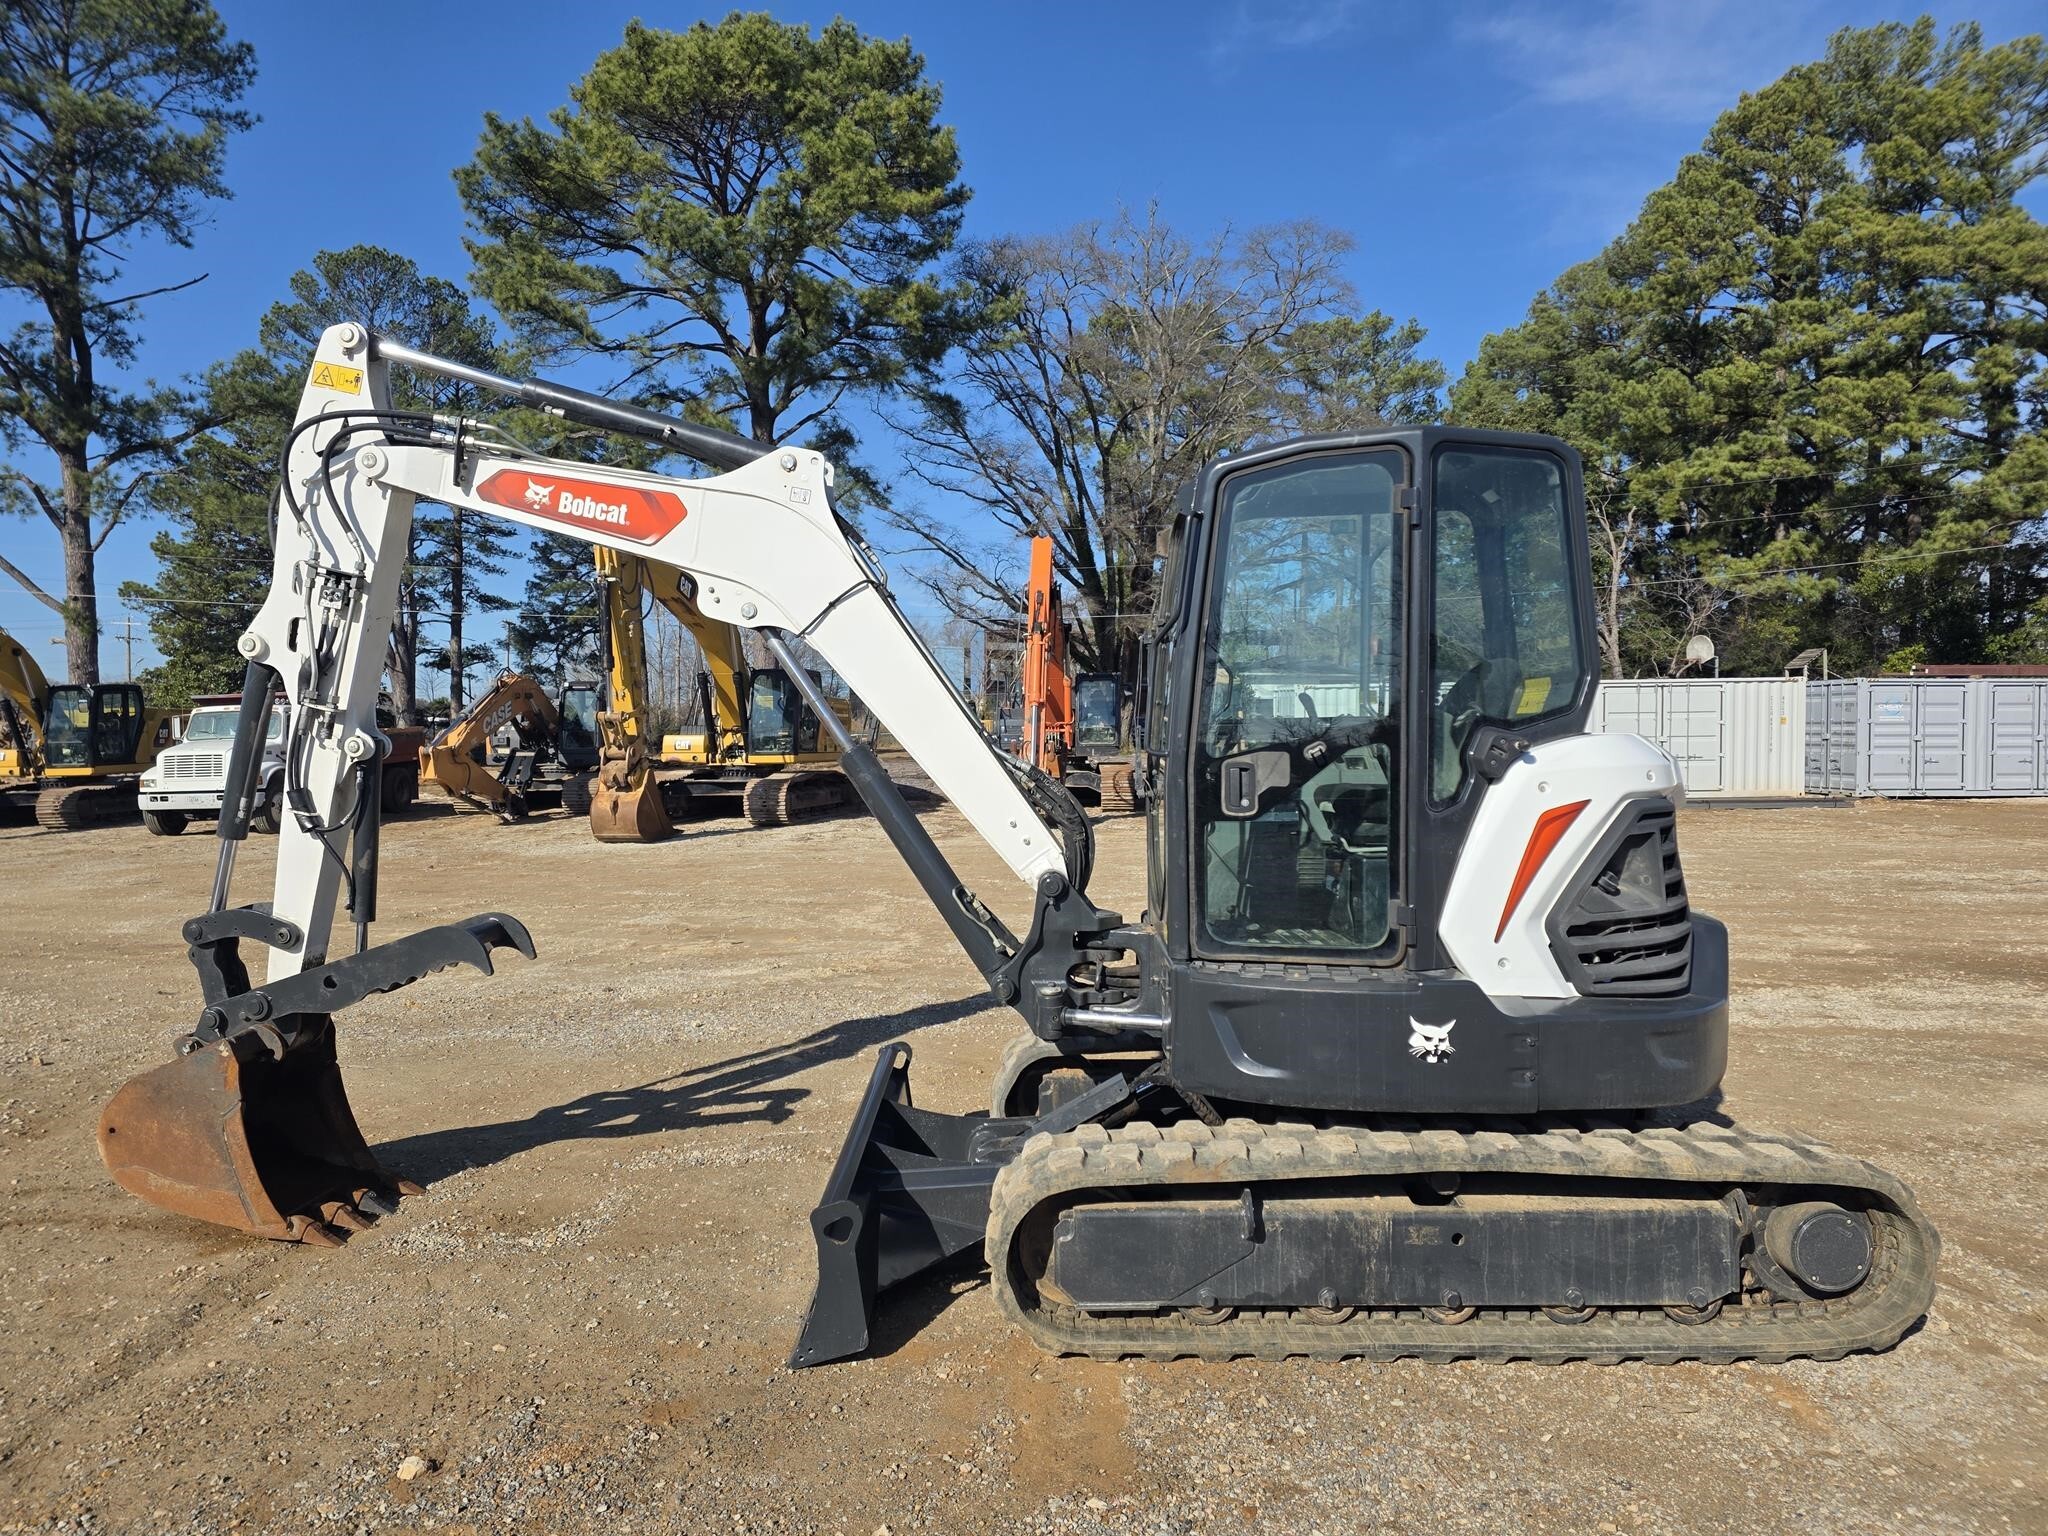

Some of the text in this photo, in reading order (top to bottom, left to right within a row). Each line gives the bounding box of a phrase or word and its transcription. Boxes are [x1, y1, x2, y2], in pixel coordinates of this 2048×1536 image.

[558, 491, 628, 526] Bobcat
[680, 576, 692, 598] CAT
[483, 700, 512, 734] CASE
[159, 728, 169, 738] CAT
